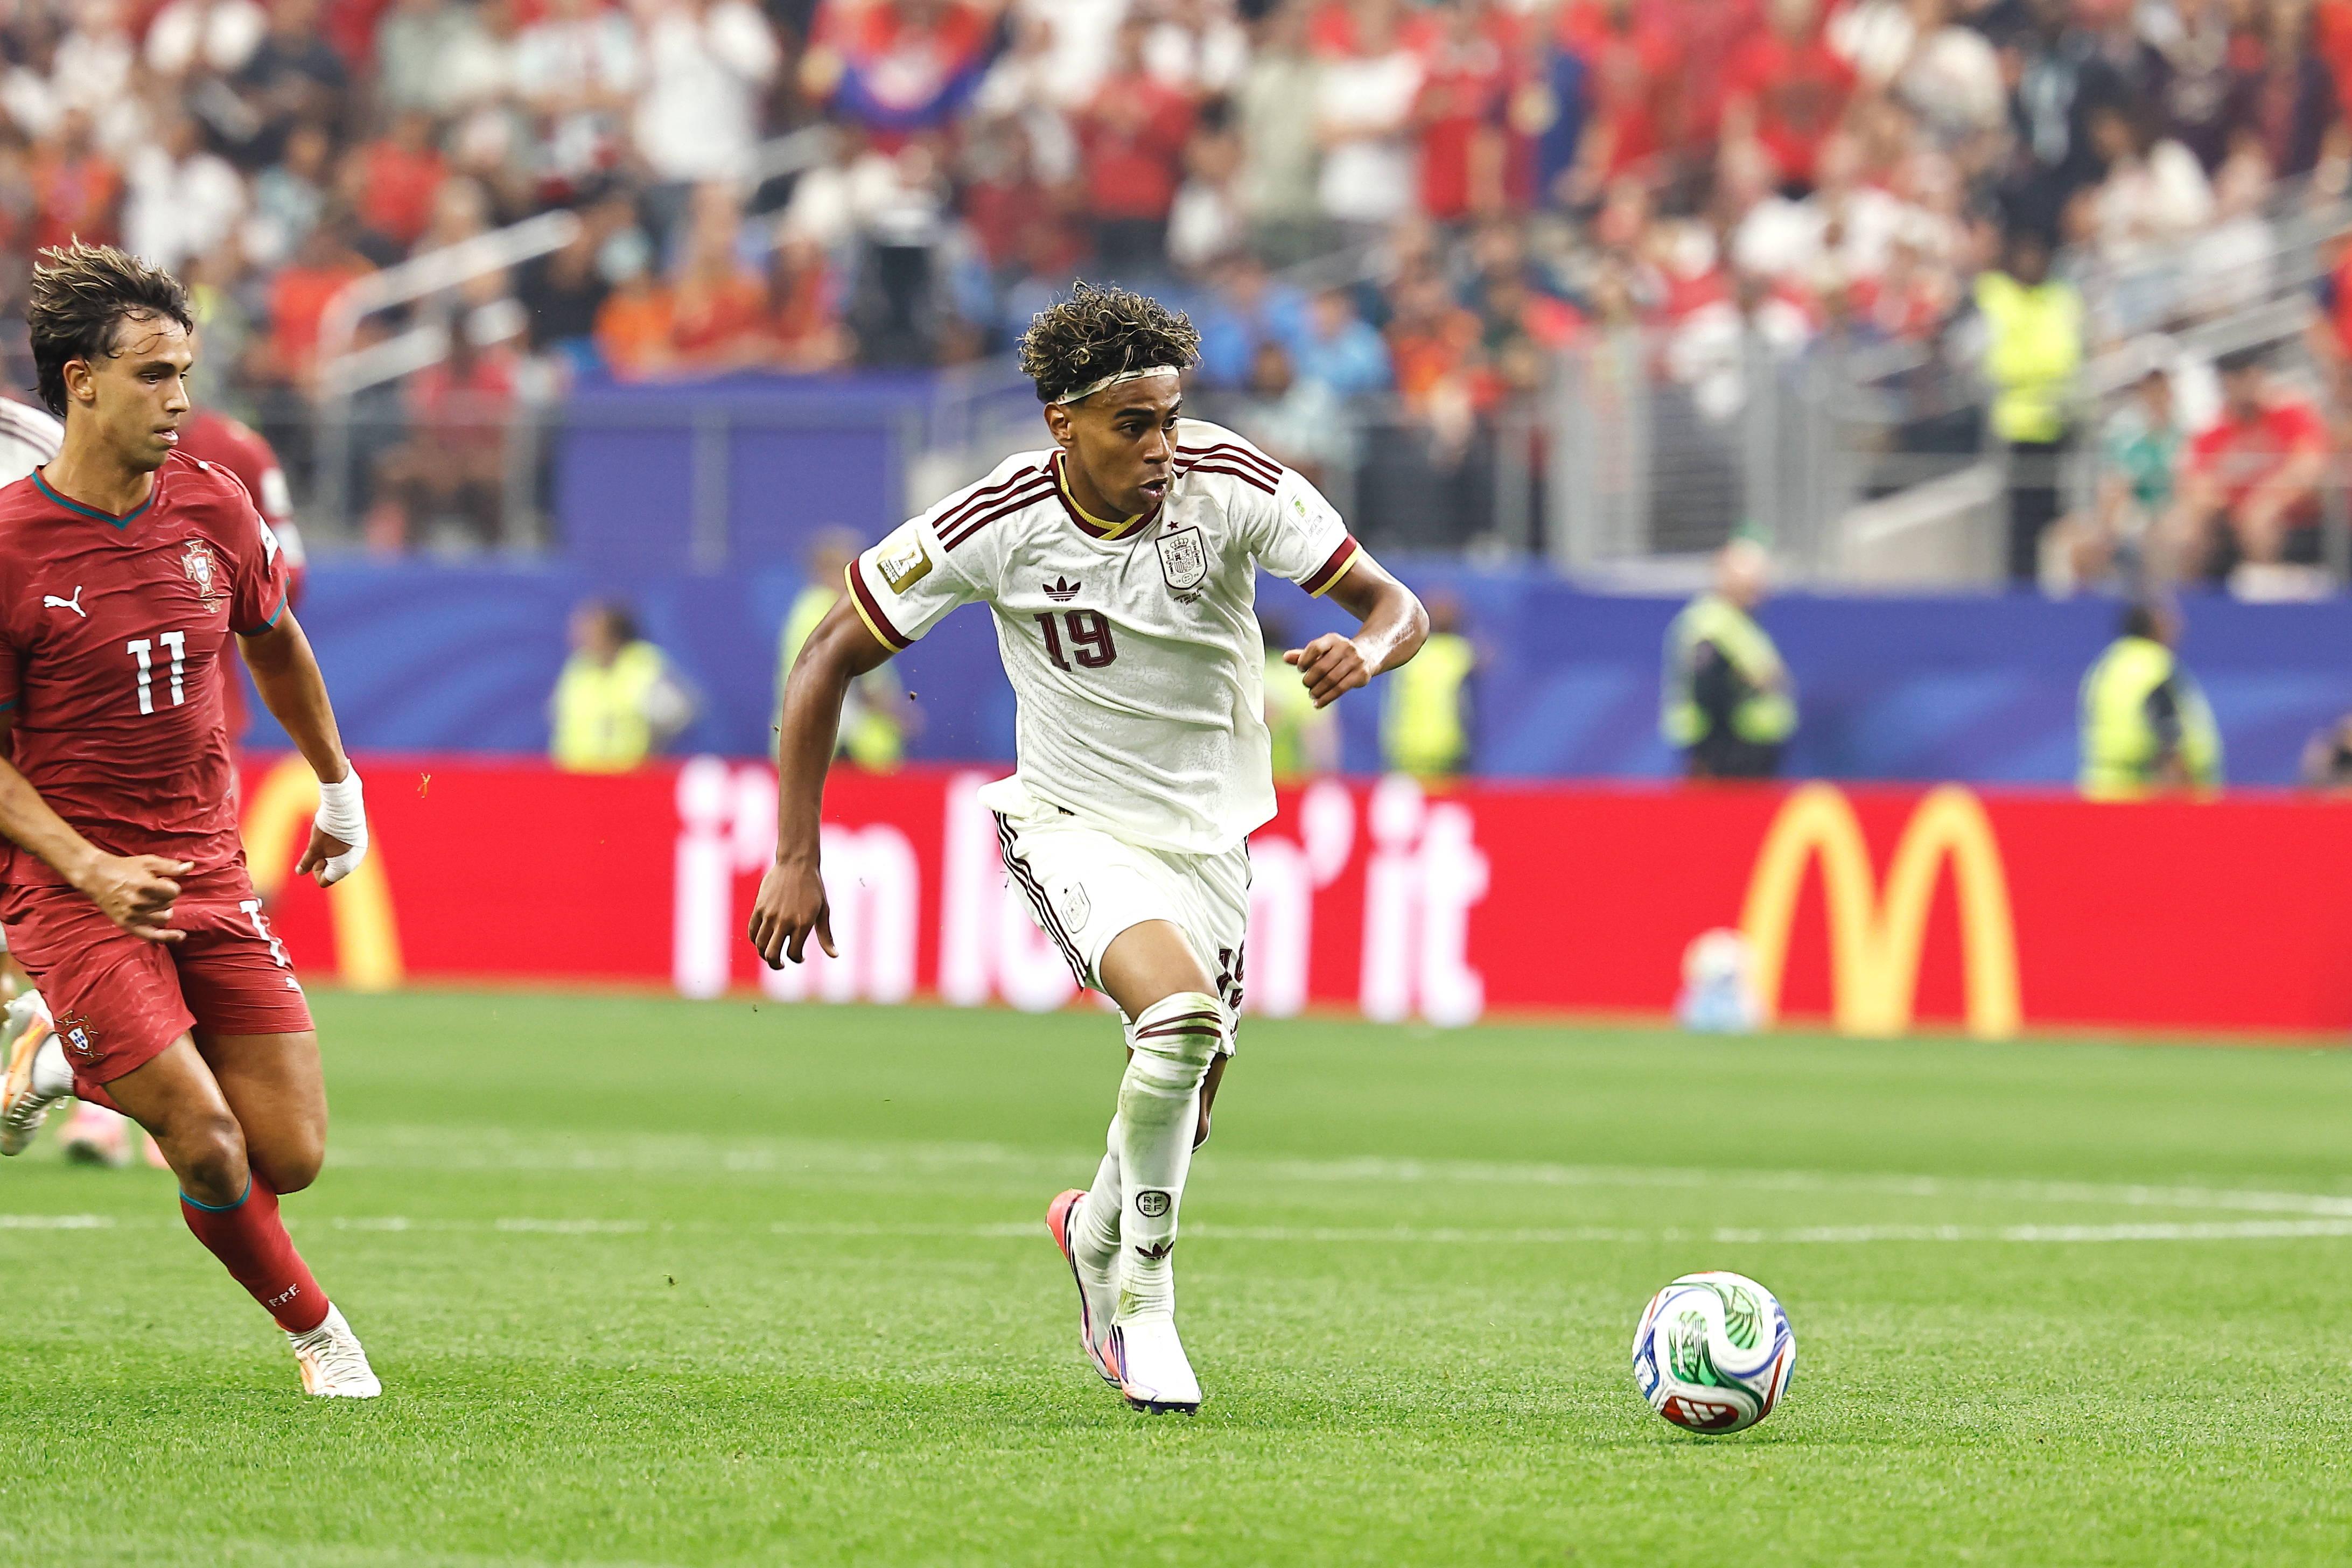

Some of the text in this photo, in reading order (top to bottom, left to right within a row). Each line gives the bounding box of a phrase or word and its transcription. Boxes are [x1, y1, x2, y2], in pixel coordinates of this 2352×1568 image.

[127, 631, 185, 715] 11
[1033, 609, 1117, 672] 19
[239, 898, 285, 967] 1
[1361, 773, 1490, 1026] it
